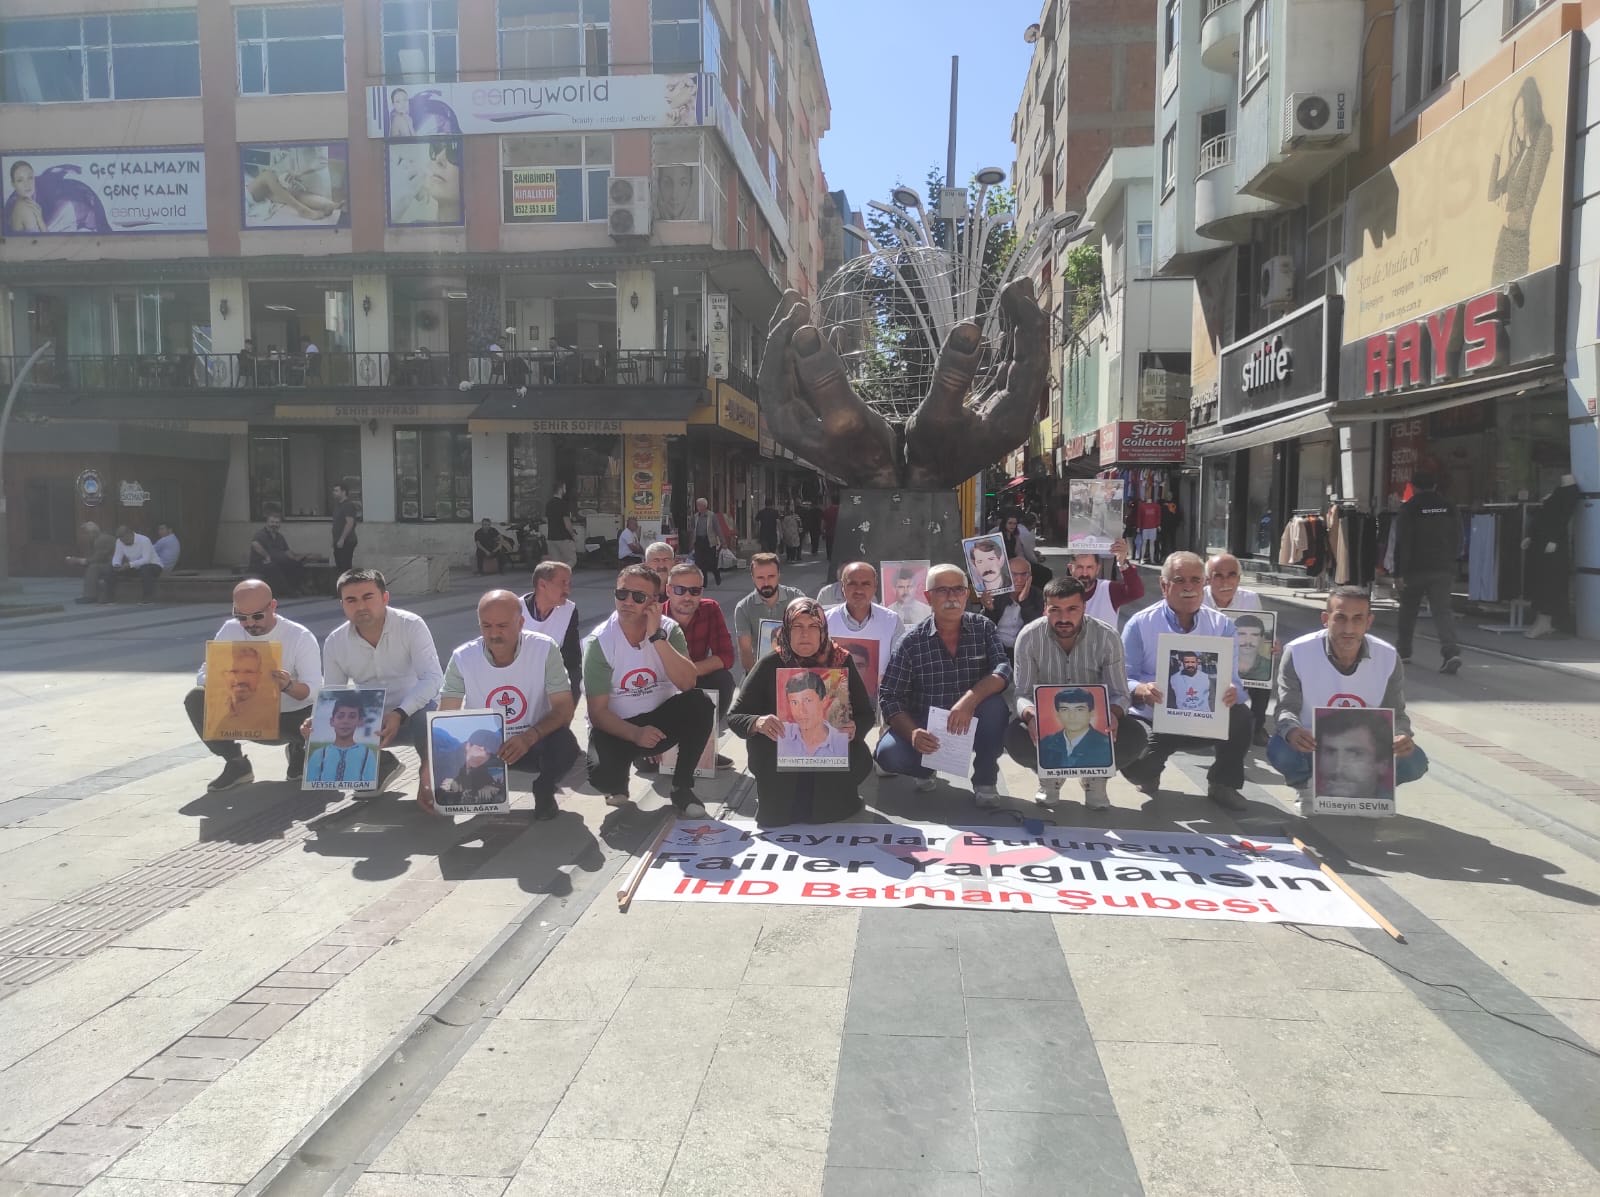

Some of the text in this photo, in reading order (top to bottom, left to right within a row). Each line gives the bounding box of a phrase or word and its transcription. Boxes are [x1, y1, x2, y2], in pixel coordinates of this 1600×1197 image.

[1337, 93, 1345, 130] BEKO
[121, 160, 200, 175] KALMAYIN
[103, 183, 188, 200] GENÇ KALIN
[1365, 290, 1498, 396] RAYS
[1242, 335, 1291, 392] stilife
[1131, 424, 1174, 439] Şirin
[1122, 437, 1182, 447] Collection
[1080, 767, 1108, 775] MALTU
[311, 781, 336, 789] VEYSEL
[1319, 800, 1356, 811] Hüseyin
[738, 829, 945, 848] Kayıplar
[963, 834, 1216, 858] Bulunsun
[650, 851, 1331, 894] Failler Yargılansın
[801, 881, 1035, 905] Batman
[1057, 889, 1281, 913] Şubesi
